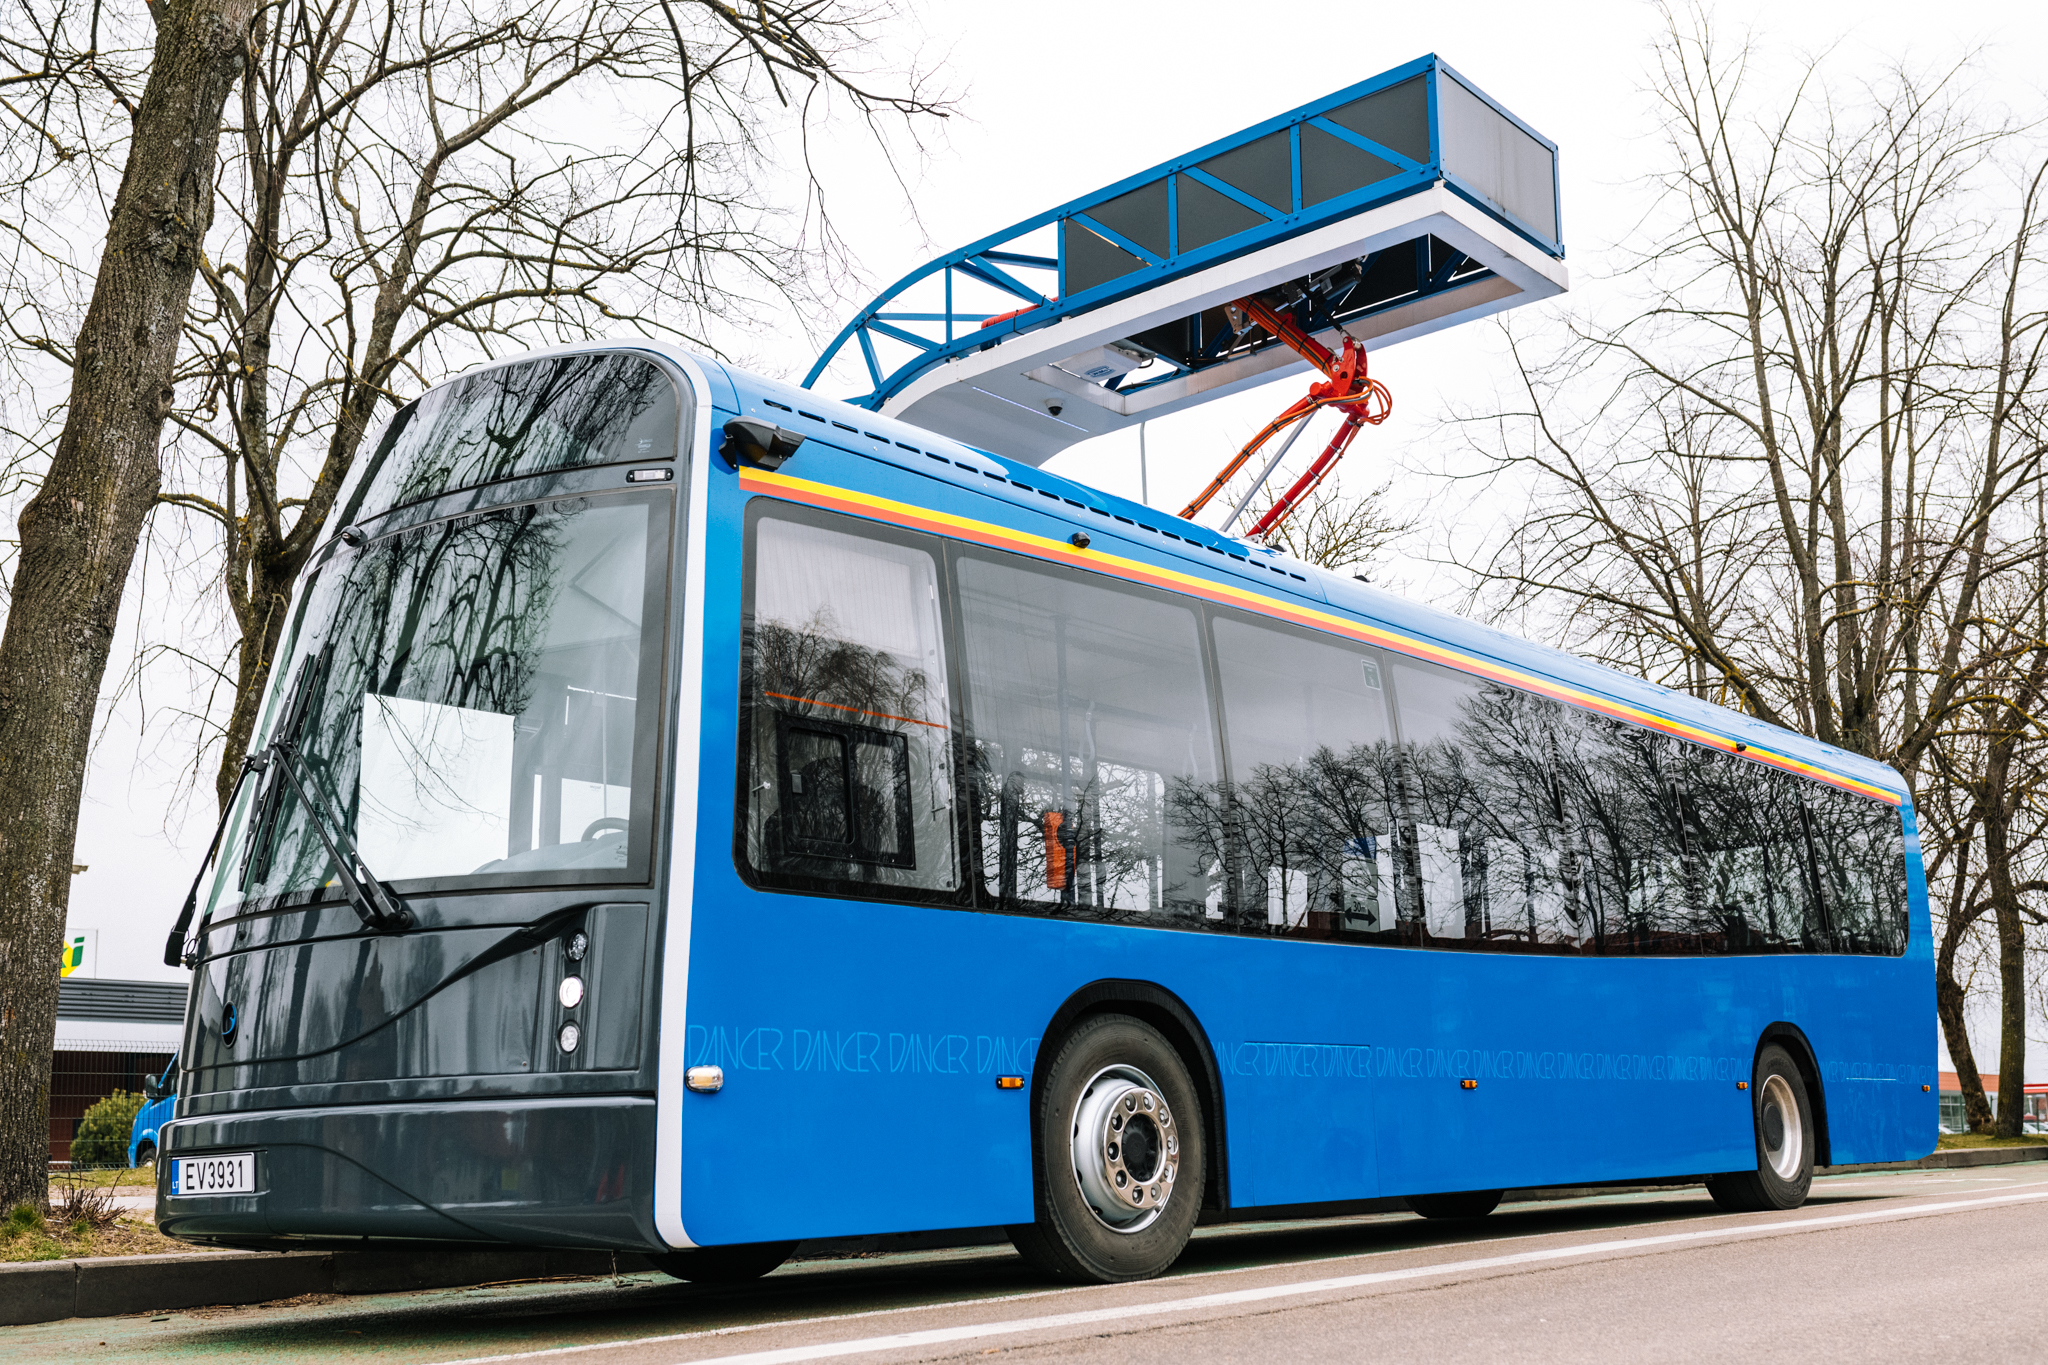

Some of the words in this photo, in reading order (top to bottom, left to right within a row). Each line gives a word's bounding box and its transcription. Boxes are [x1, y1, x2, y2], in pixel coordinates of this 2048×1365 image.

[687, 1024, 784, 1072] DANCER
[793, 1028, 883, 1073] DANCER
[889, 1032, 969, 1074] DANCER
[976, 1035, 1042, 1075] DANCE
[1376, 1046, 1424, 1078] DANCER
[1426, 1048, 1471, 1078] DANCER
[1472, 1049, 1515, 1079] DANCER
[1516, 1051, 1556, 1079] DANCER
[172, 1181, 179, 1189] LT
[186, 1160, 243, 1190] EV3931
